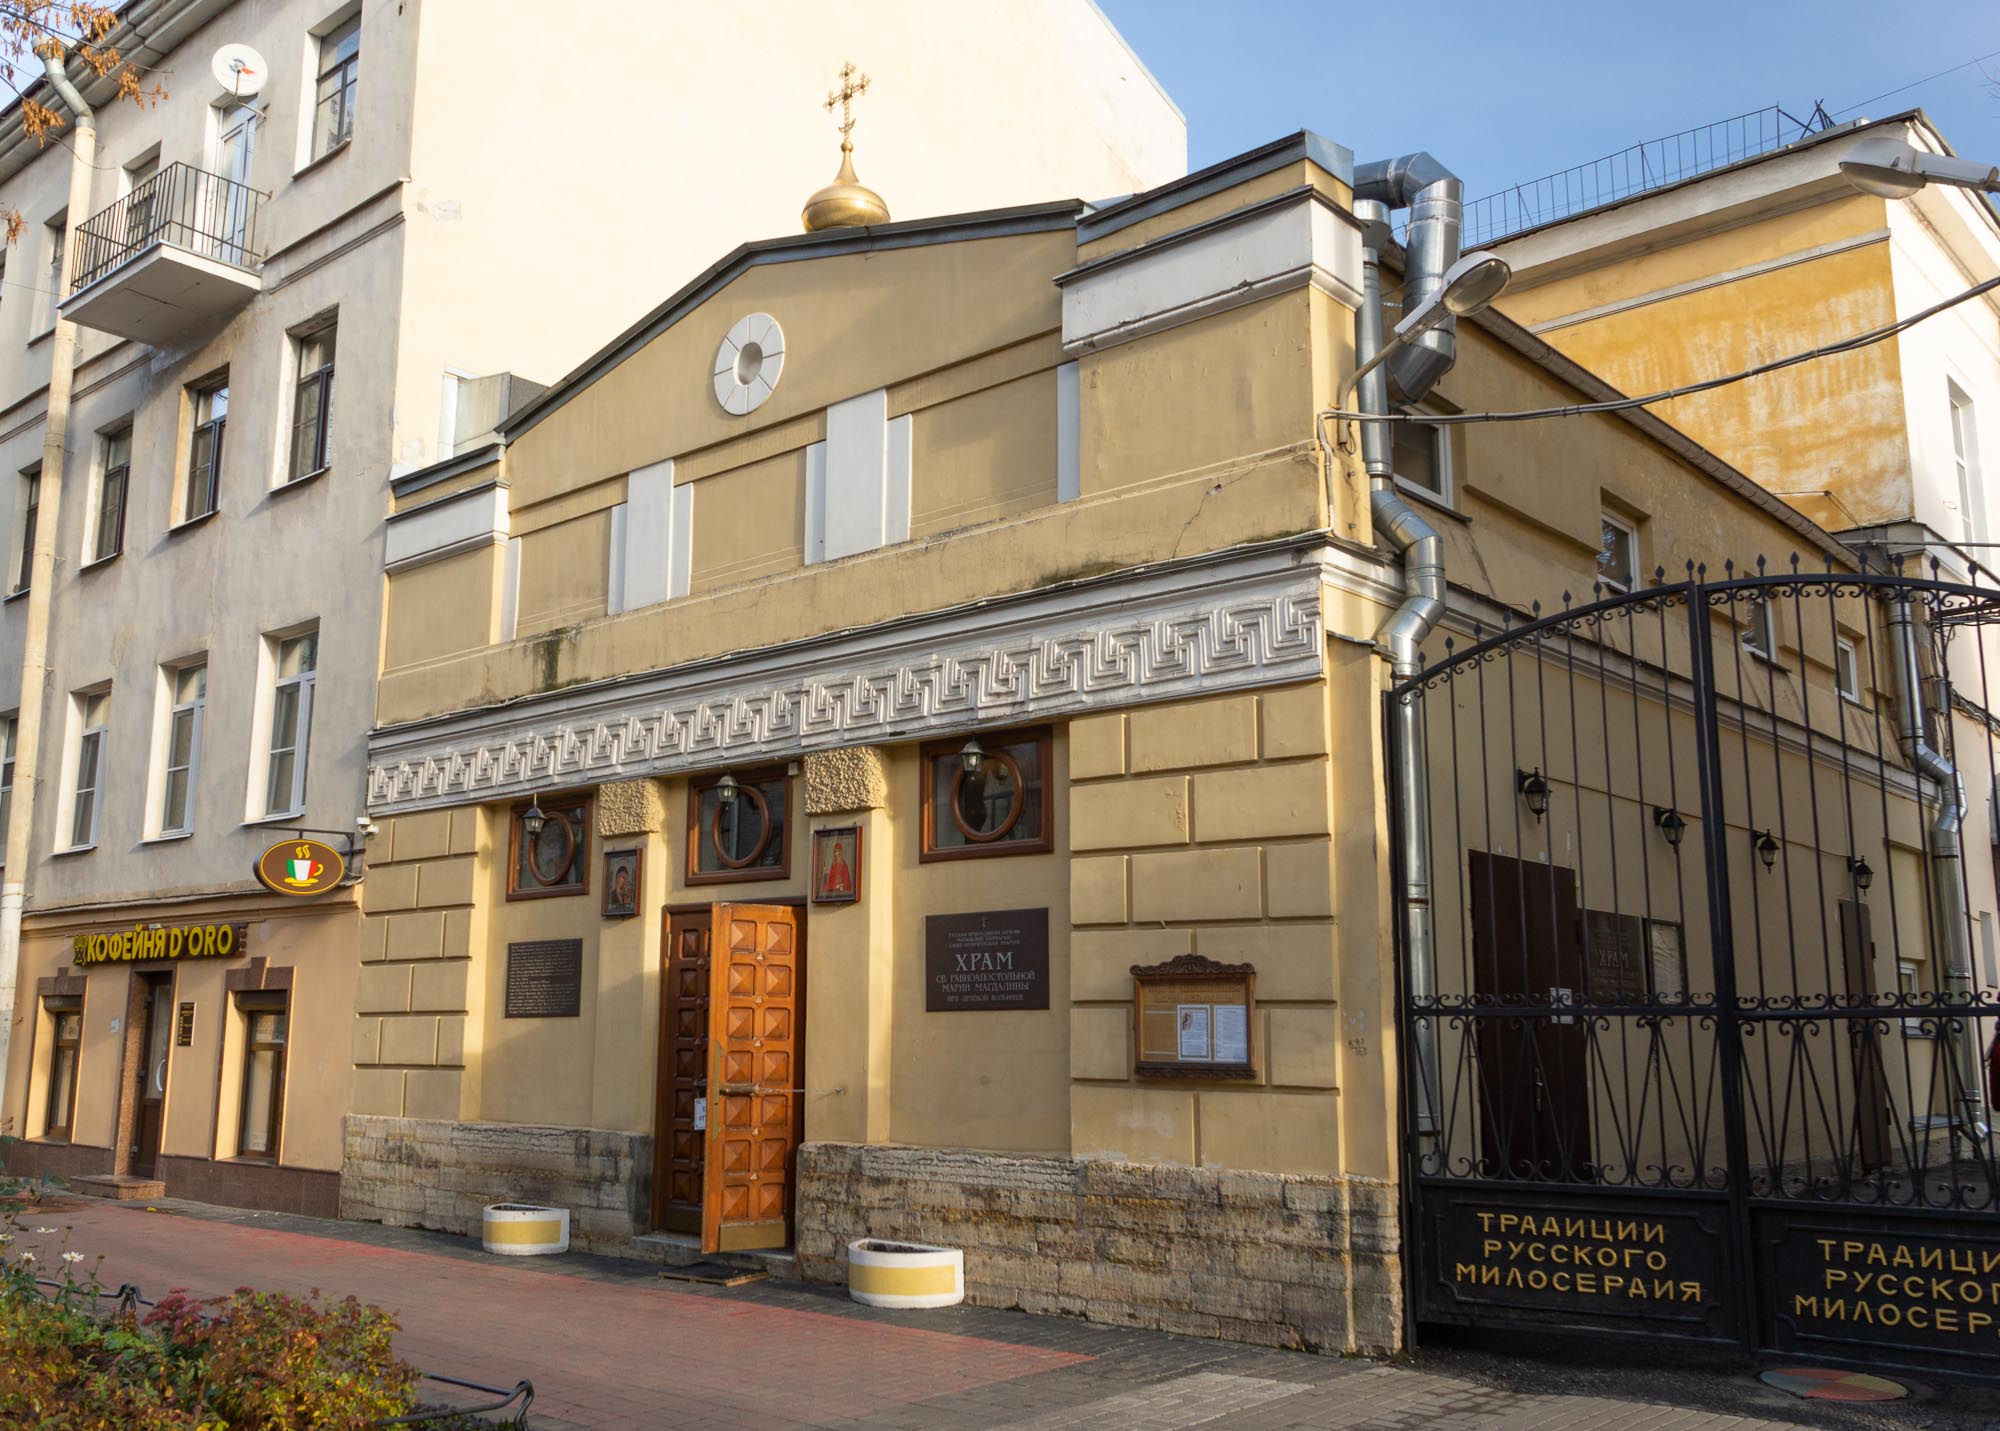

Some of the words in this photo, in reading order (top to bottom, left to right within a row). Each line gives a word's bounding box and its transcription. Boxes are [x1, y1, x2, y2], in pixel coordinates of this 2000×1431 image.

[87, 923, 166, 962] КОФЕЙНЯ
[169, 923, 233, 958] D'ORO
[955, 951, 1014, 972] ХРАМ
[1477, 1212, 1665, 1244] ТРАДИЦИИ
[1484, 1239, 1667, 1271] РУССКОГО
[1456, 1262, 1701, 1303] МИЛОСЕРДИЯ
[1795, 1295, 2000, 1338] МИЛОСЕР
